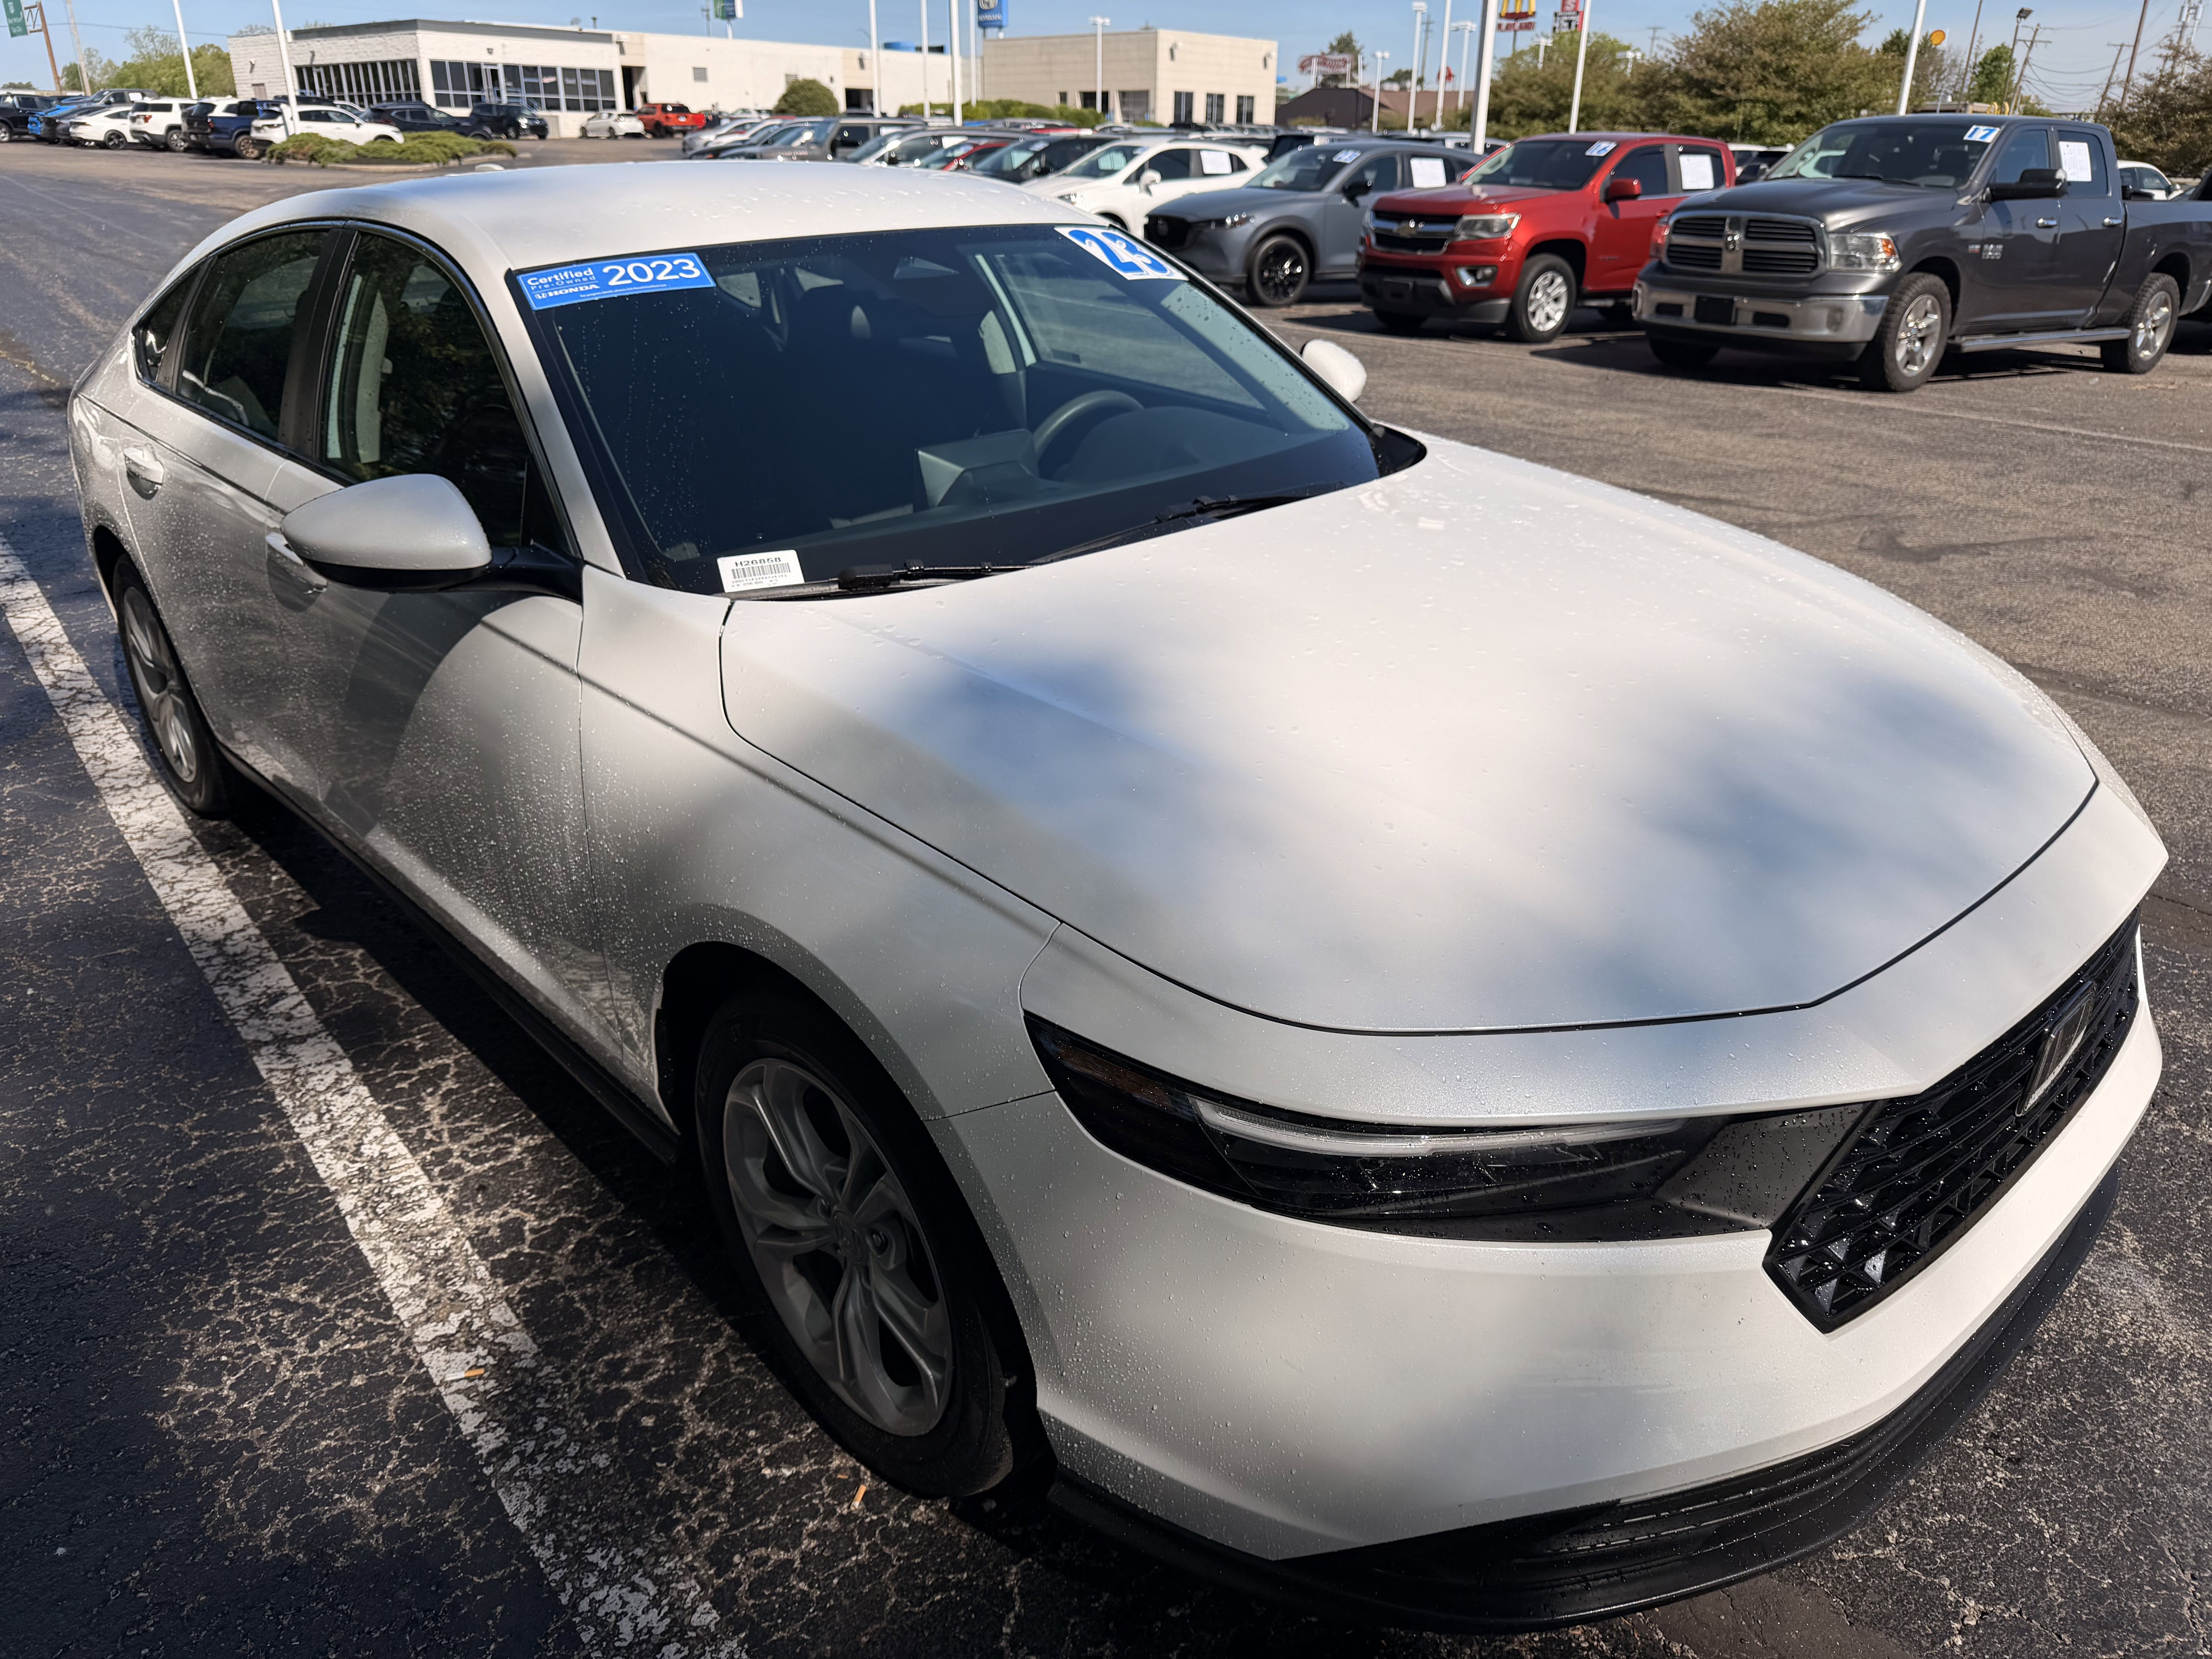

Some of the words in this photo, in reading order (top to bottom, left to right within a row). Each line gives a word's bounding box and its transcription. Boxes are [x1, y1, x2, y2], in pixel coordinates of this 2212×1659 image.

[1967, 127, 1996, 139] 17
[1068, 229, 1171, 276] 23
[527, 267, 593, 286] Certified
[602, 258, 701, 286] 2023
[531, 275, 596, 291] Pre-Owned
[547, 283, 600, 297] HONDA
